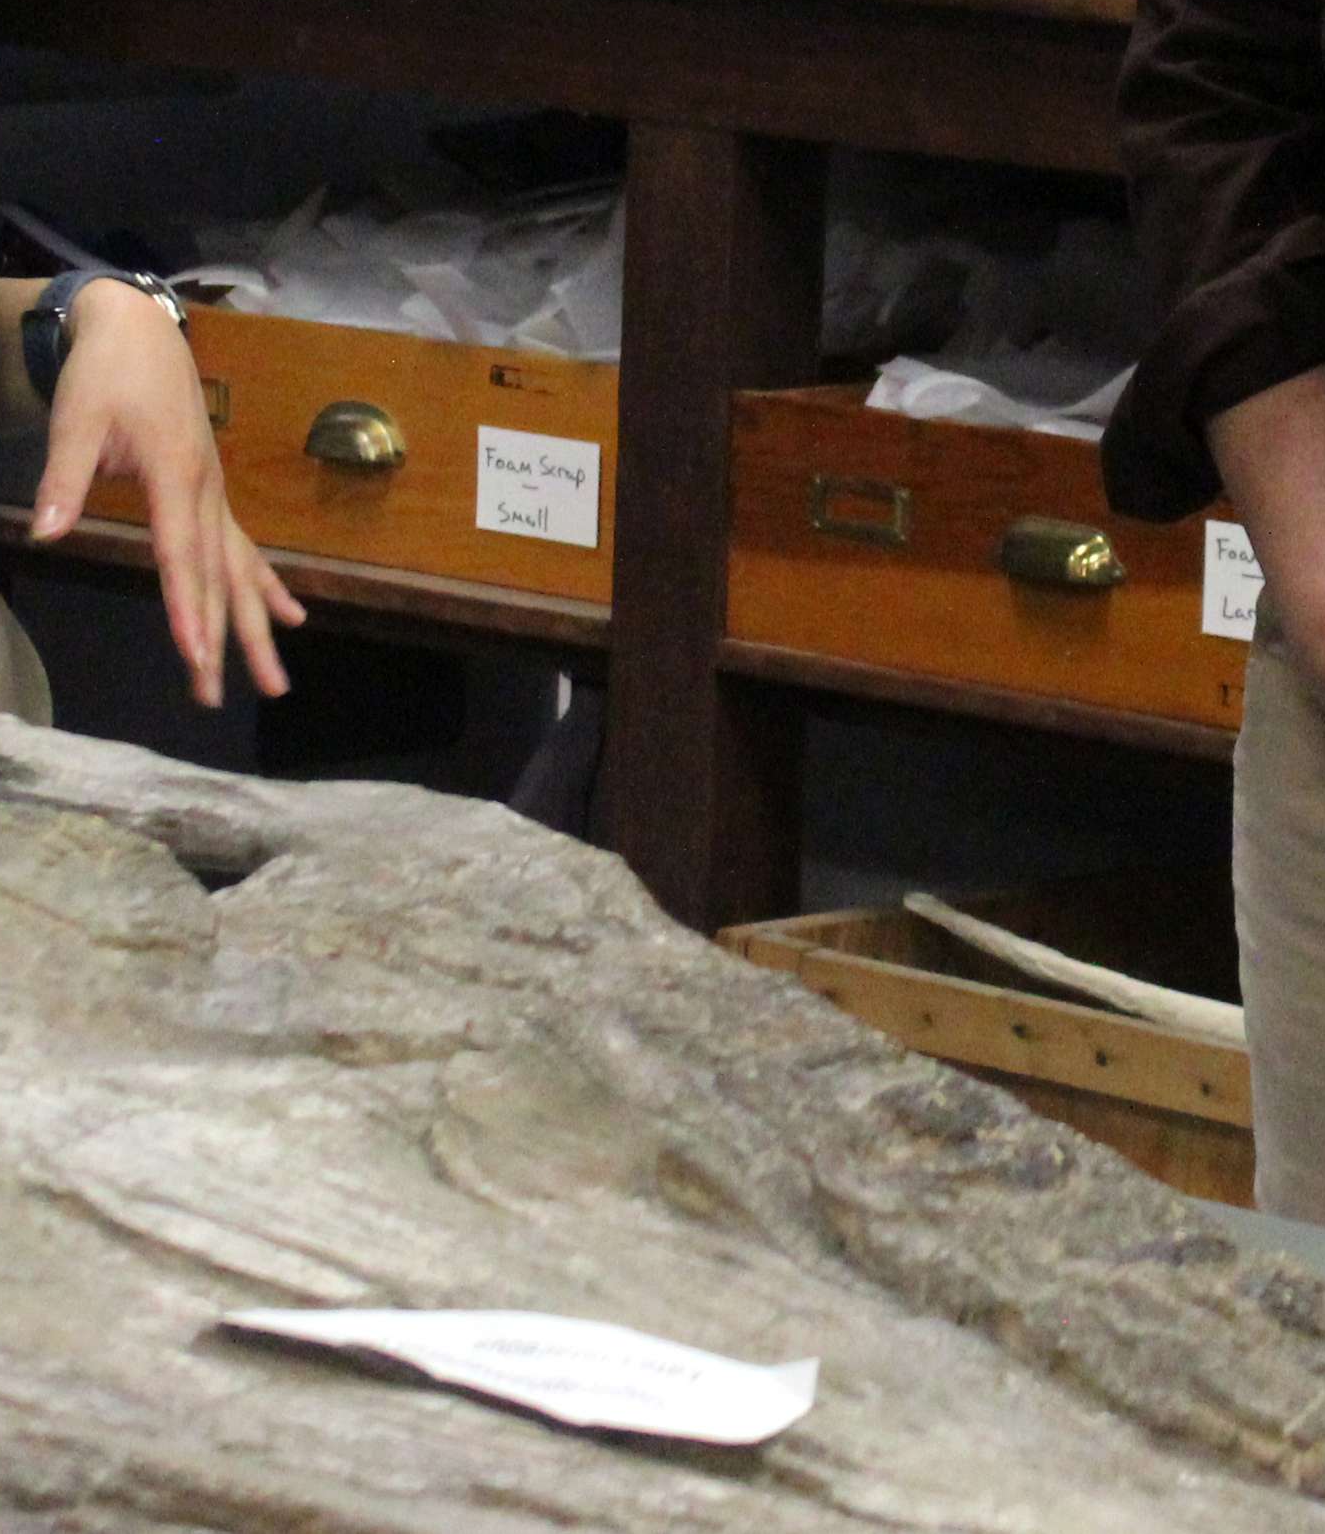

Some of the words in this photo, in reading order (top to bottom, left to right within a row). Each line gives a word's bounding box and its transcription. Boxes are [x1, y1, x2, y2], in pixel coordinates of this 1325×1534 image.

[497, 501, 549, 533] Small
[1216, 537, 1256, 563] Foa
[1222, 595, 1256, 621] Lar
